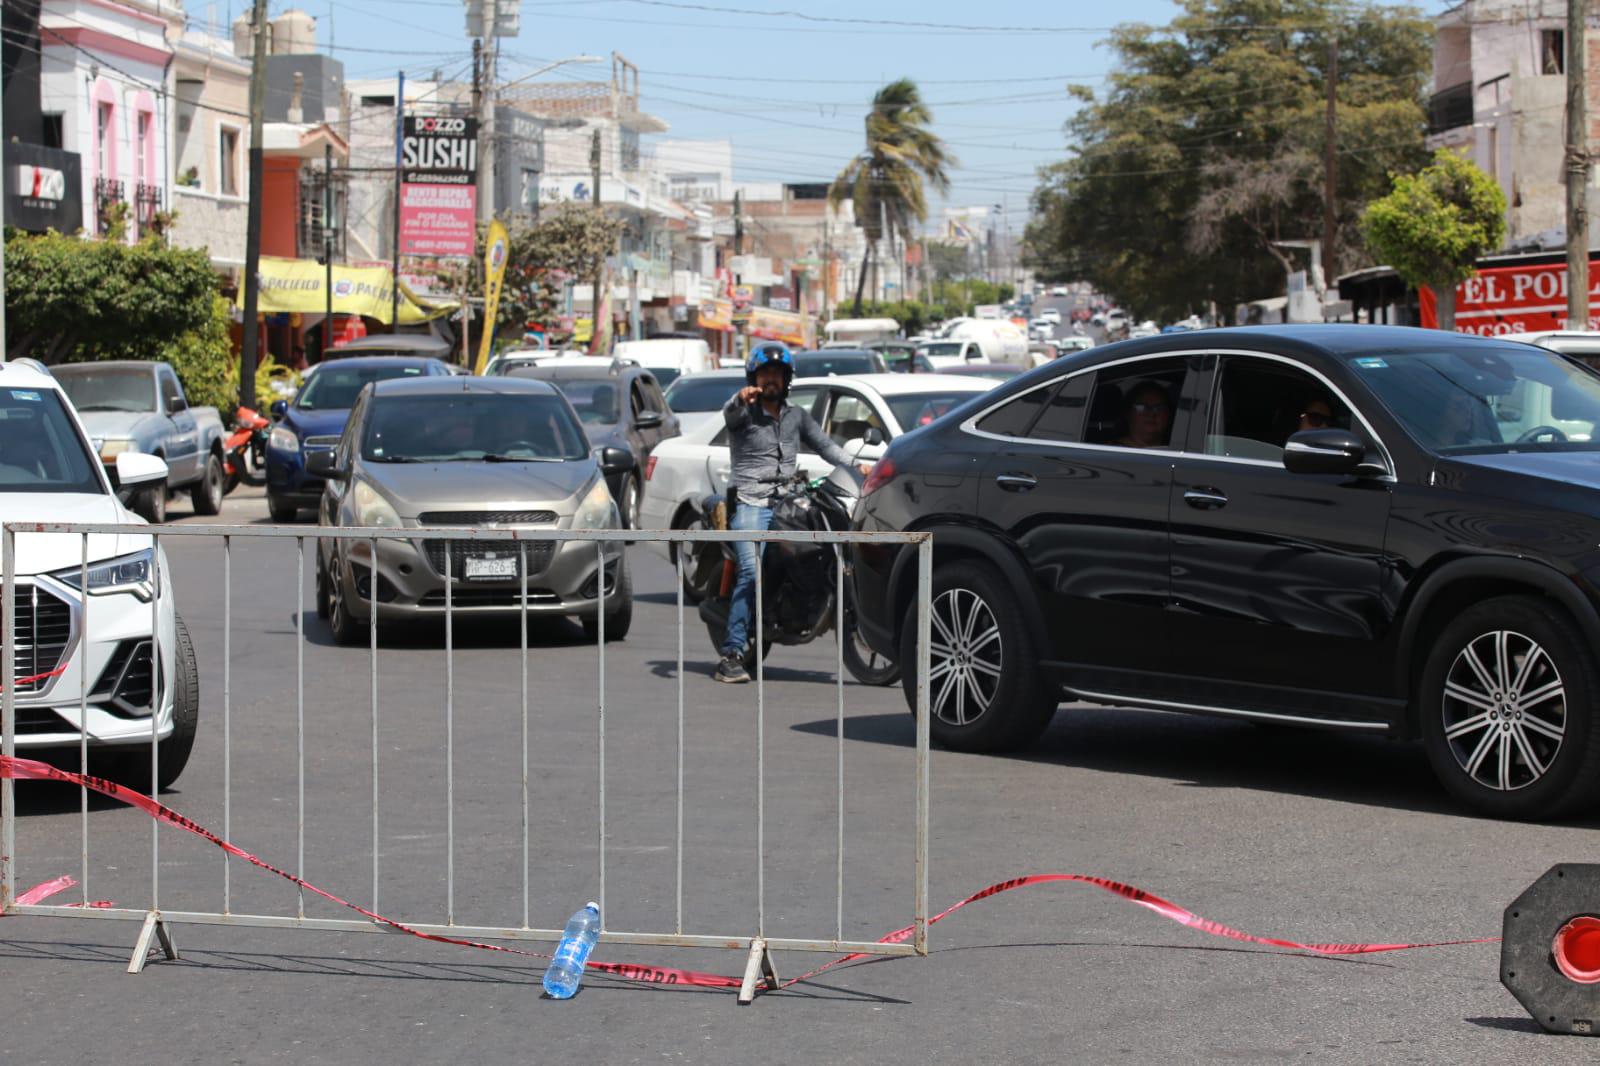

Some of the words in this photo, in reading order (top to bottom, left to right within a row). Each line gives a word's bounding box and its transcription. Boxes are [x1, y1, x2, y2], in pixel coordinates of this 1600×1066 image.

[415, 118, 466, 132] DOZZO
[403, 137, 476, 171] SUSHI
[268, 278, 320, 292] PACIFICO
[1455, 321, 1526, 337] ACOS
